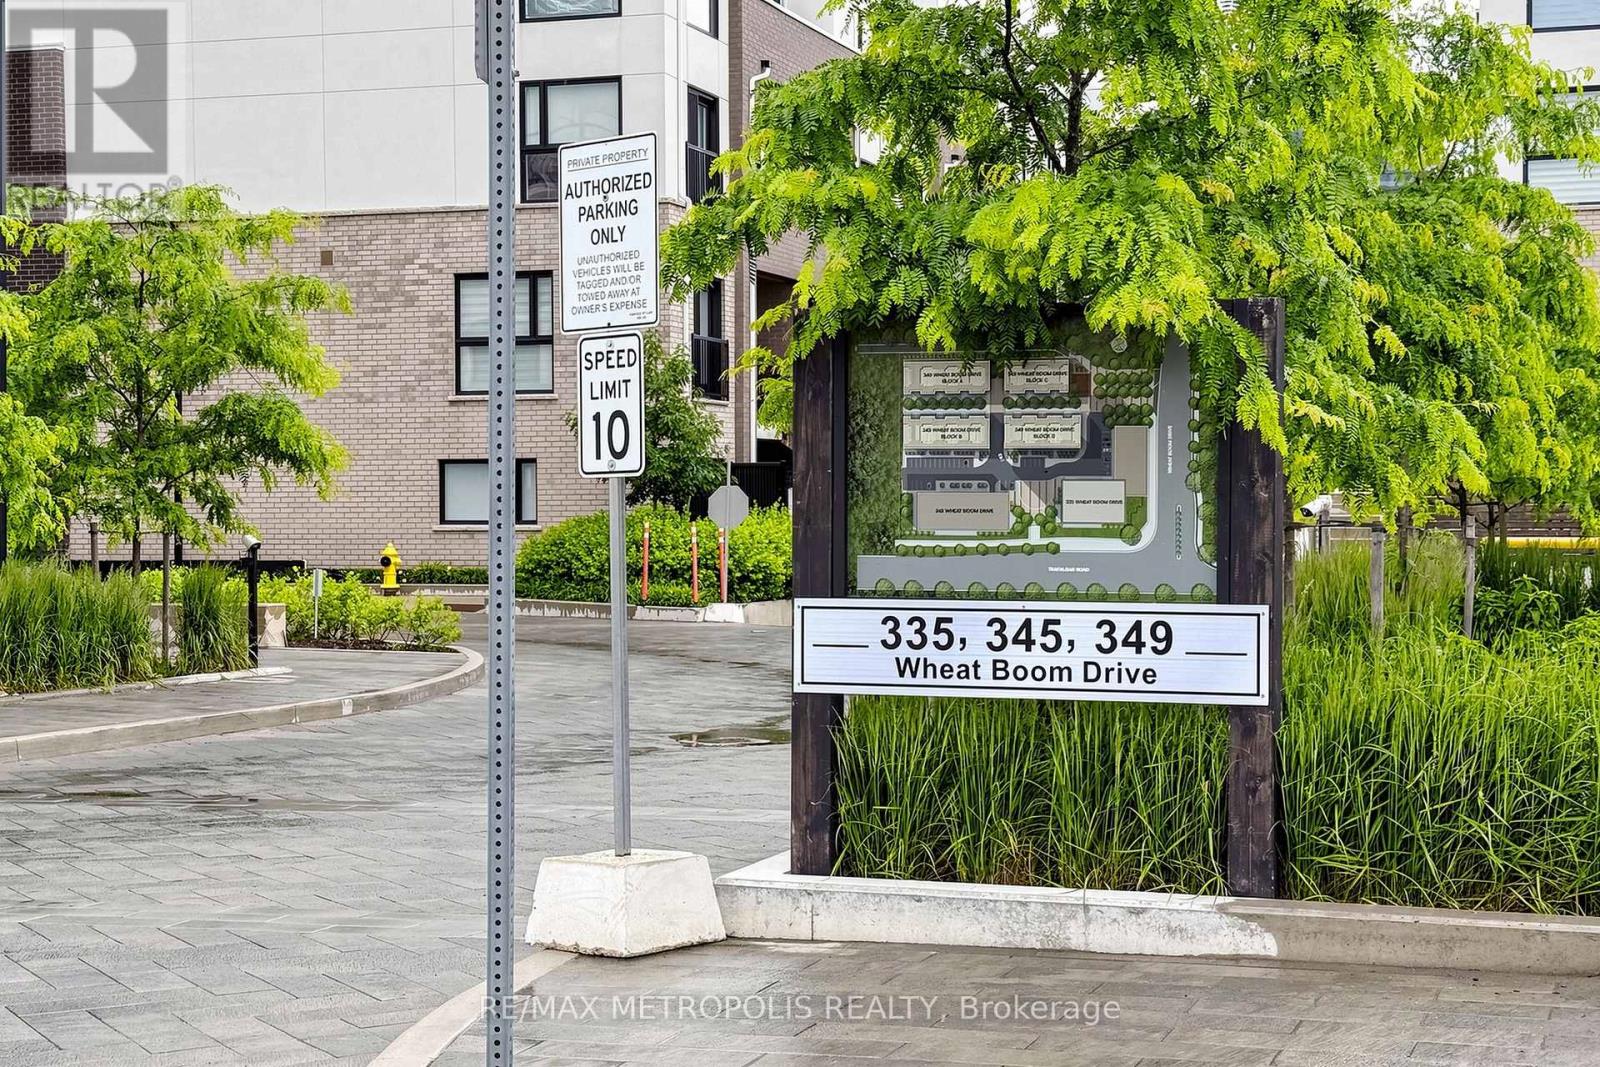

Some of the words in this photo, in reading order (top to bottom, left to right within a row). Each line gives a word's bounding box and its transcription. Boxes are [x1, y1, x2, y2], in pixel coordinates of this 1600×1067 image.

[567, 155, 600, 169] PRIVATE
[602, 148, 648, 163] PROPERTY
[565, 172, 652, 200] AUTHORIZED
[578, 199, 639, 223] PARKING
[590, 225, 626, 246] ONLY
[577, 250, 640, 266] UNAUTHORIZED
[572, 265, 611, 279] VEHICLES
[613, 263, 632, 274] WILL
[634, 262, 645, 272] BE
[577, 278, 609, 290] TAGGED
[577, 291, 606, 303] TOWED
[607, 288, 629, 300] AWAY
[631, 287, 641, 297] AT
[609, 298, 648, 312] EXPENSE
[584, 348, 637, 371] SPEED
[590, 379, 631, 400] LIMIT
[592, 410, 630, 460] 10
[880, 615, 967, 651] 335,
[986, 617, 1075, 654] 345,
[1095, 619, 1174, 656] 349
[895, 656, 981, 681] Wheat
[992, 658, 1073, 682] Boom
[1083, 660, 1158, 685] Drive
